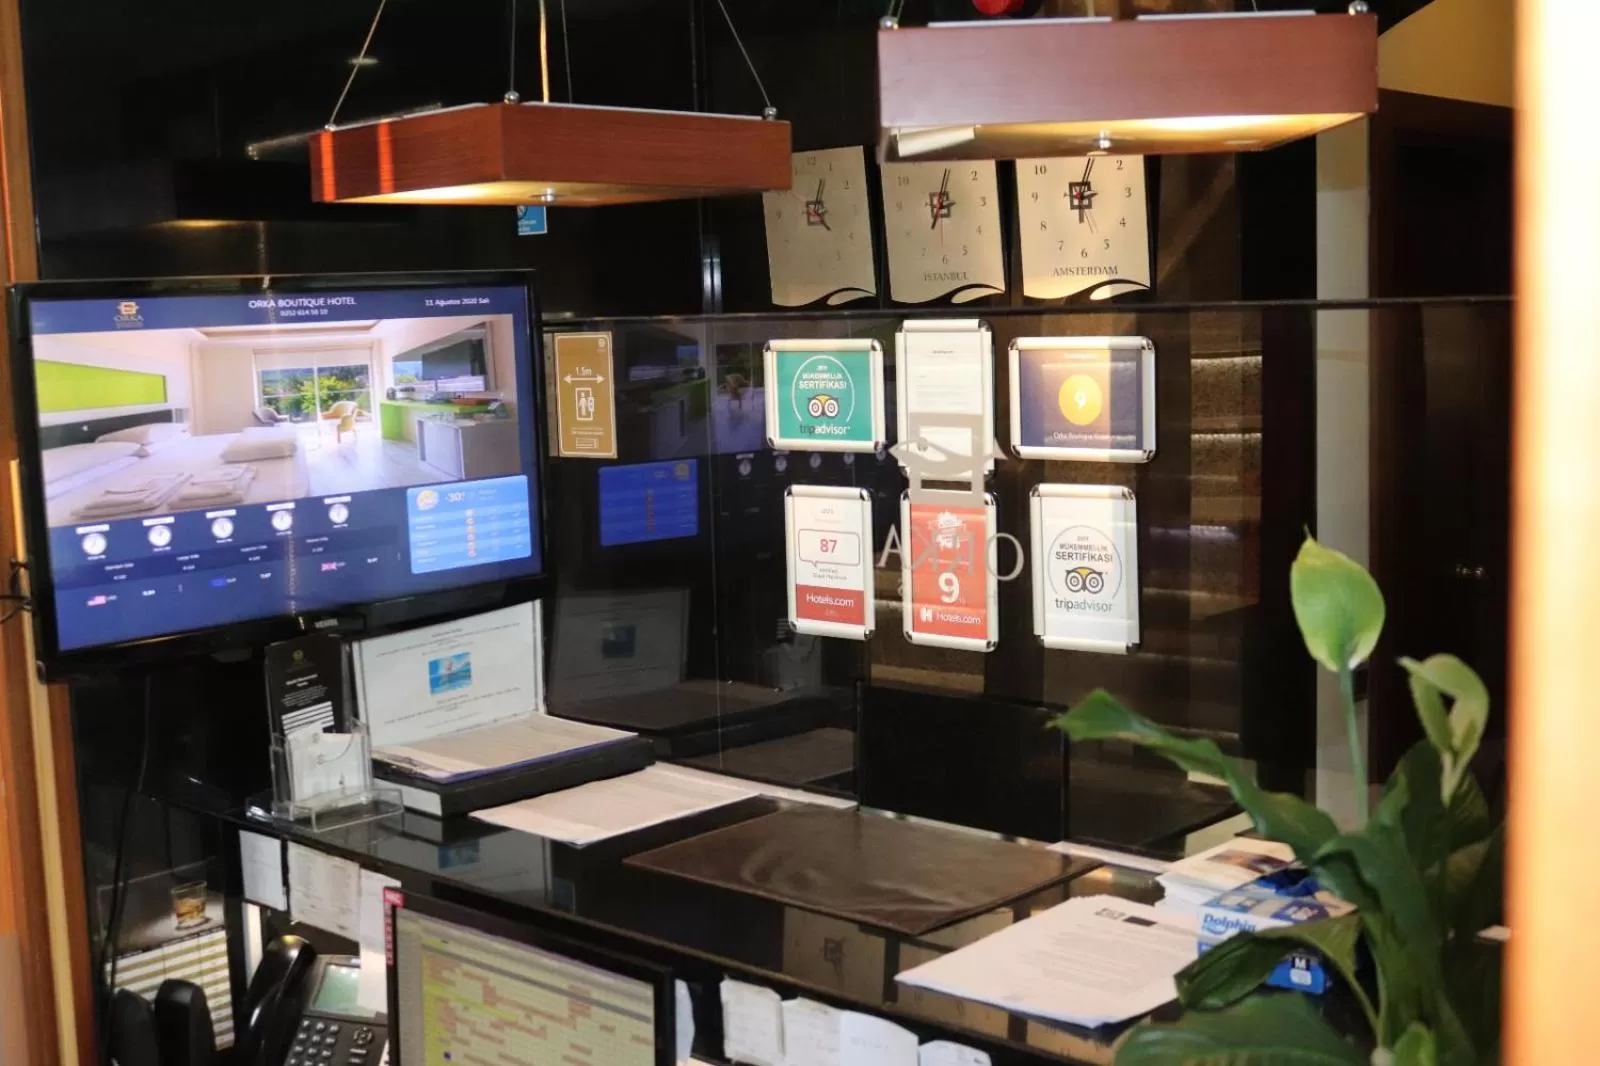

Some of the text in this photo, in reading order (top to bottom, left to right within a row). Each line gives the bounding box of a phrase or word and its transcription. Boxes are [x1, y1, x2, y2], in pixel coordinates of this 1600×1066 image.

[1034, 165, 1047, 175] 10
[1116, 160, 1124, 170] 2
[971, 170, 978, 181] 2
[1125, 187, 1132, 198] 3
[980, 196, 987, 207] 3
[1119, 217, 1126, 227] 4
[1103, 239, 1110, 250] 5
[1081, 248, 1088, 258] 6
[1053, 265, 1118, 277] AMSTERDAM
[278, 298, 325, 307] BOUTIQUE
[327, 296, 356, 305] HOTEL
[800, 423, 848, 435] tripadvisor
[820, 539, 837, 553] 87
[938, 572, 960, 603] 9
[806, 593, 854, 608] Hotels.com
[1055, 597, 1112, 612] tripadvisor
[936, 610, 981, 625] Hotels.com
[1204, 914, 1256, 932] Dolphin
[1294, 957, 1306, 969] M
